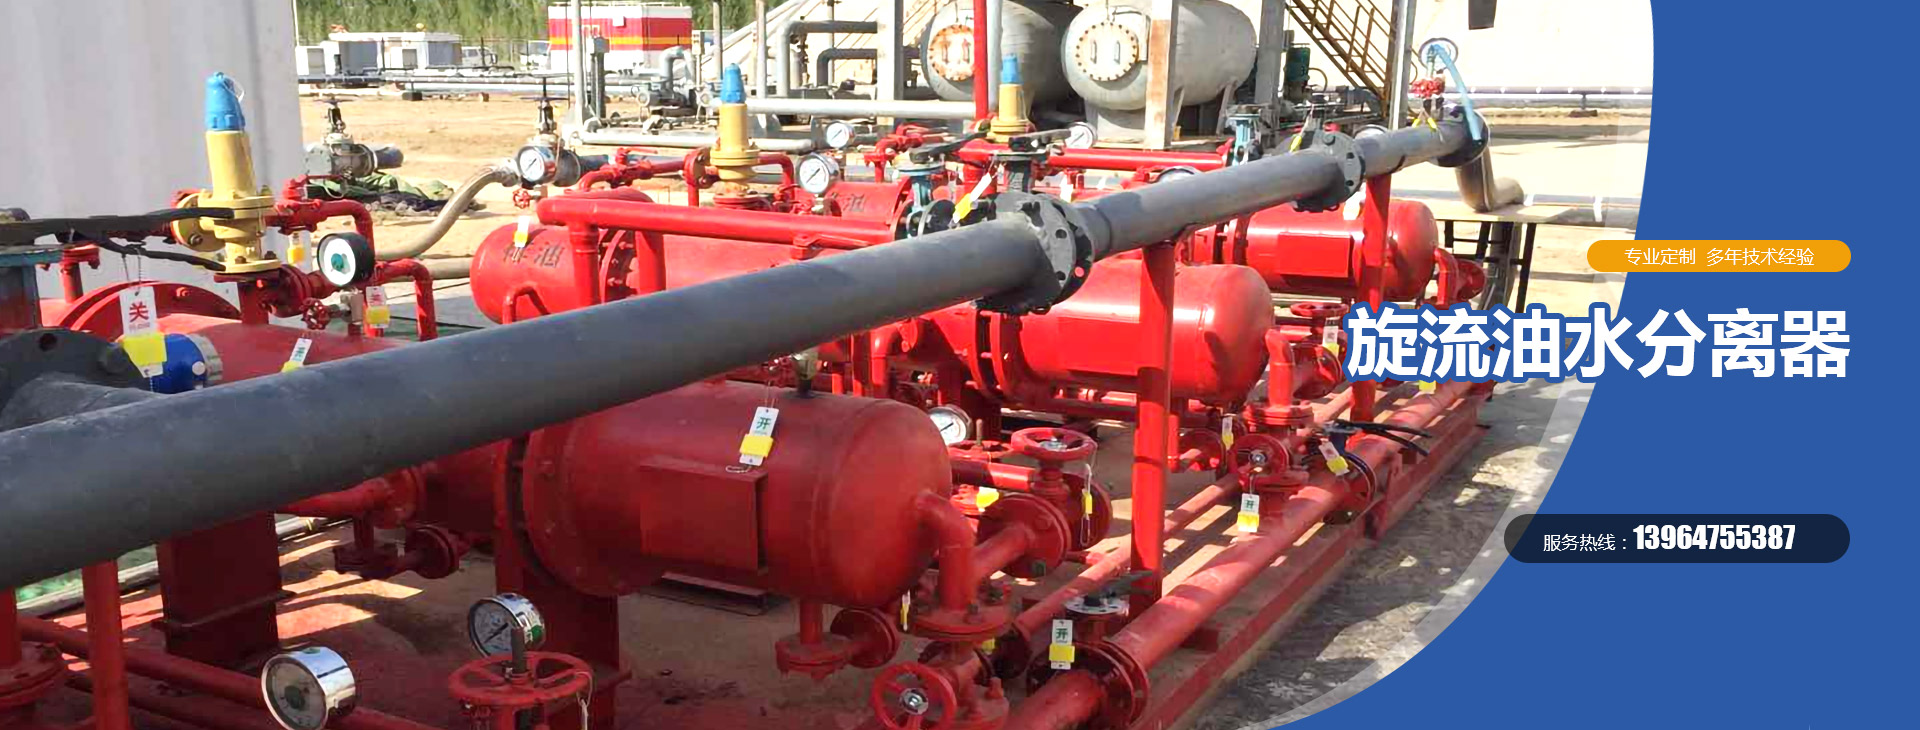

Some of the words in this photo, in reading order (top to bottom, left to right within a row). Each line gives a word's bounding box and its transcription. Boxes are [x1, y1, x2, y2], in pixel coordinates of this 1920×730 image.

[128, 301, 150, 323] 关
[755, 416, 772, 430] 开
[1055, 627, 1069, 641] 开
